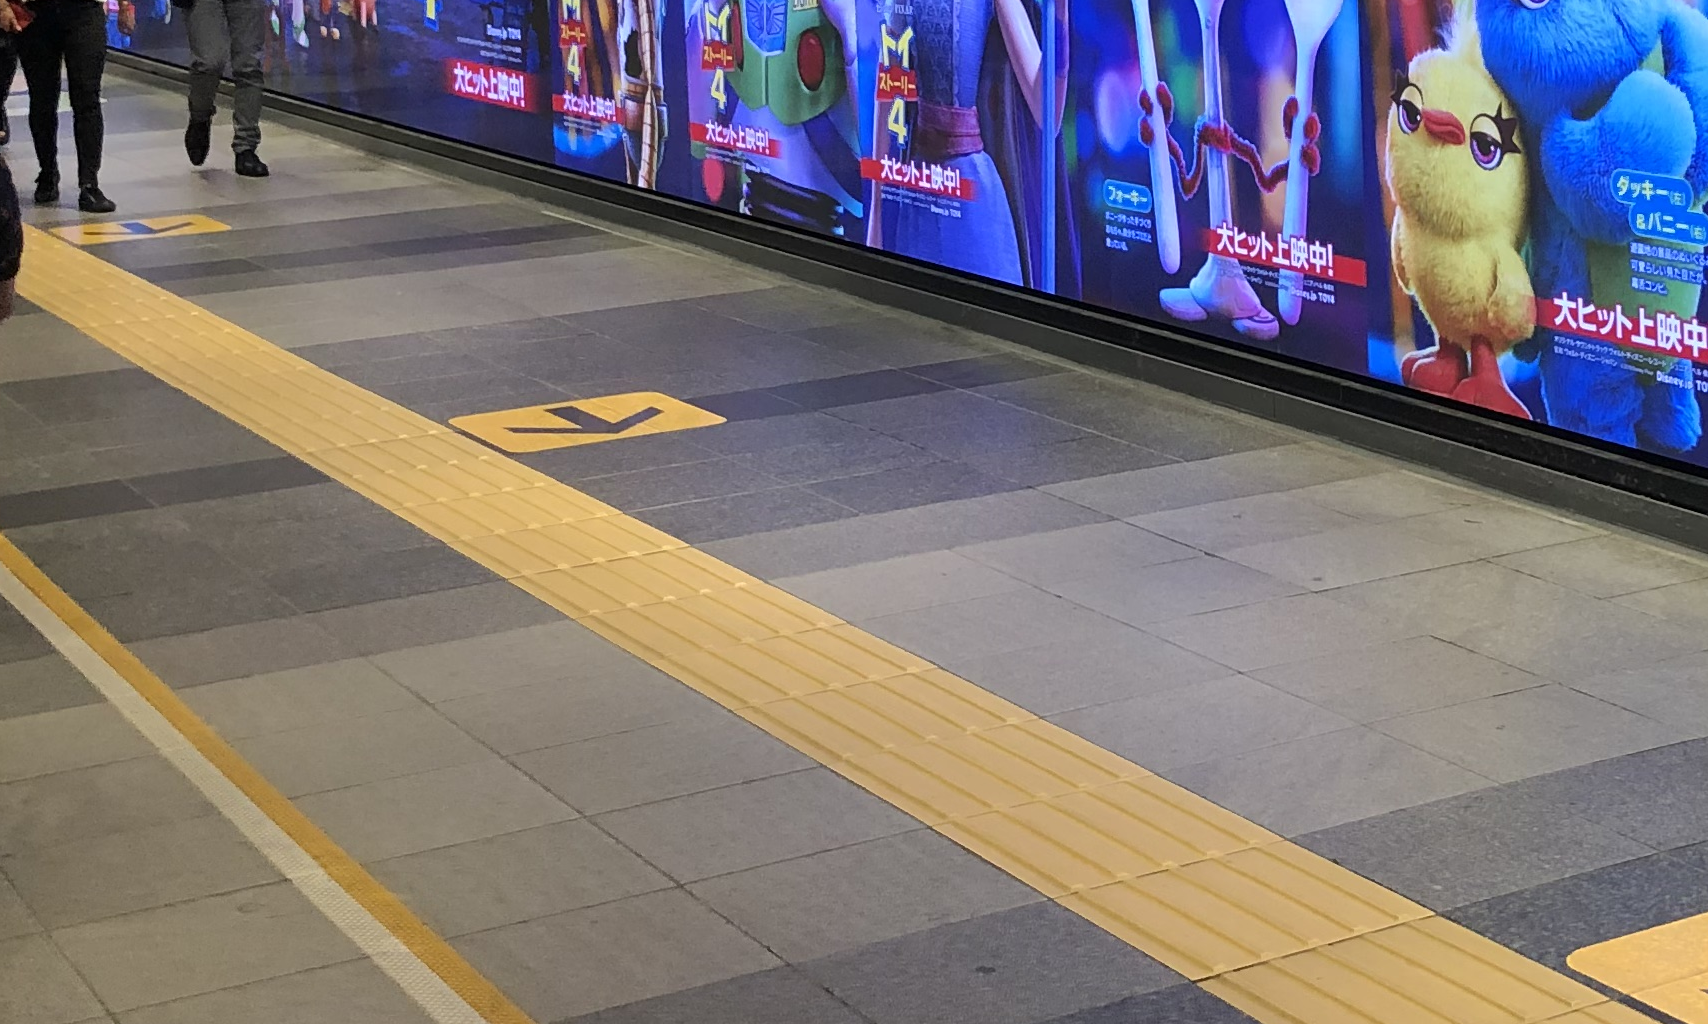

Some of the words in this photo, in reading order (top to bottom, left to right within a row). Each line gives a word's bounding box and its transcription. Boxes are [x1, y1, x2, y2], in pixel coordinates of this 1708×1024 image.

[567, 42, 582, 85] 4
[710, 66, 728, 113] 4
[887, 96, 909, 148] 4
[1216, 222, 1334, 277] 大ヒット上映中!
